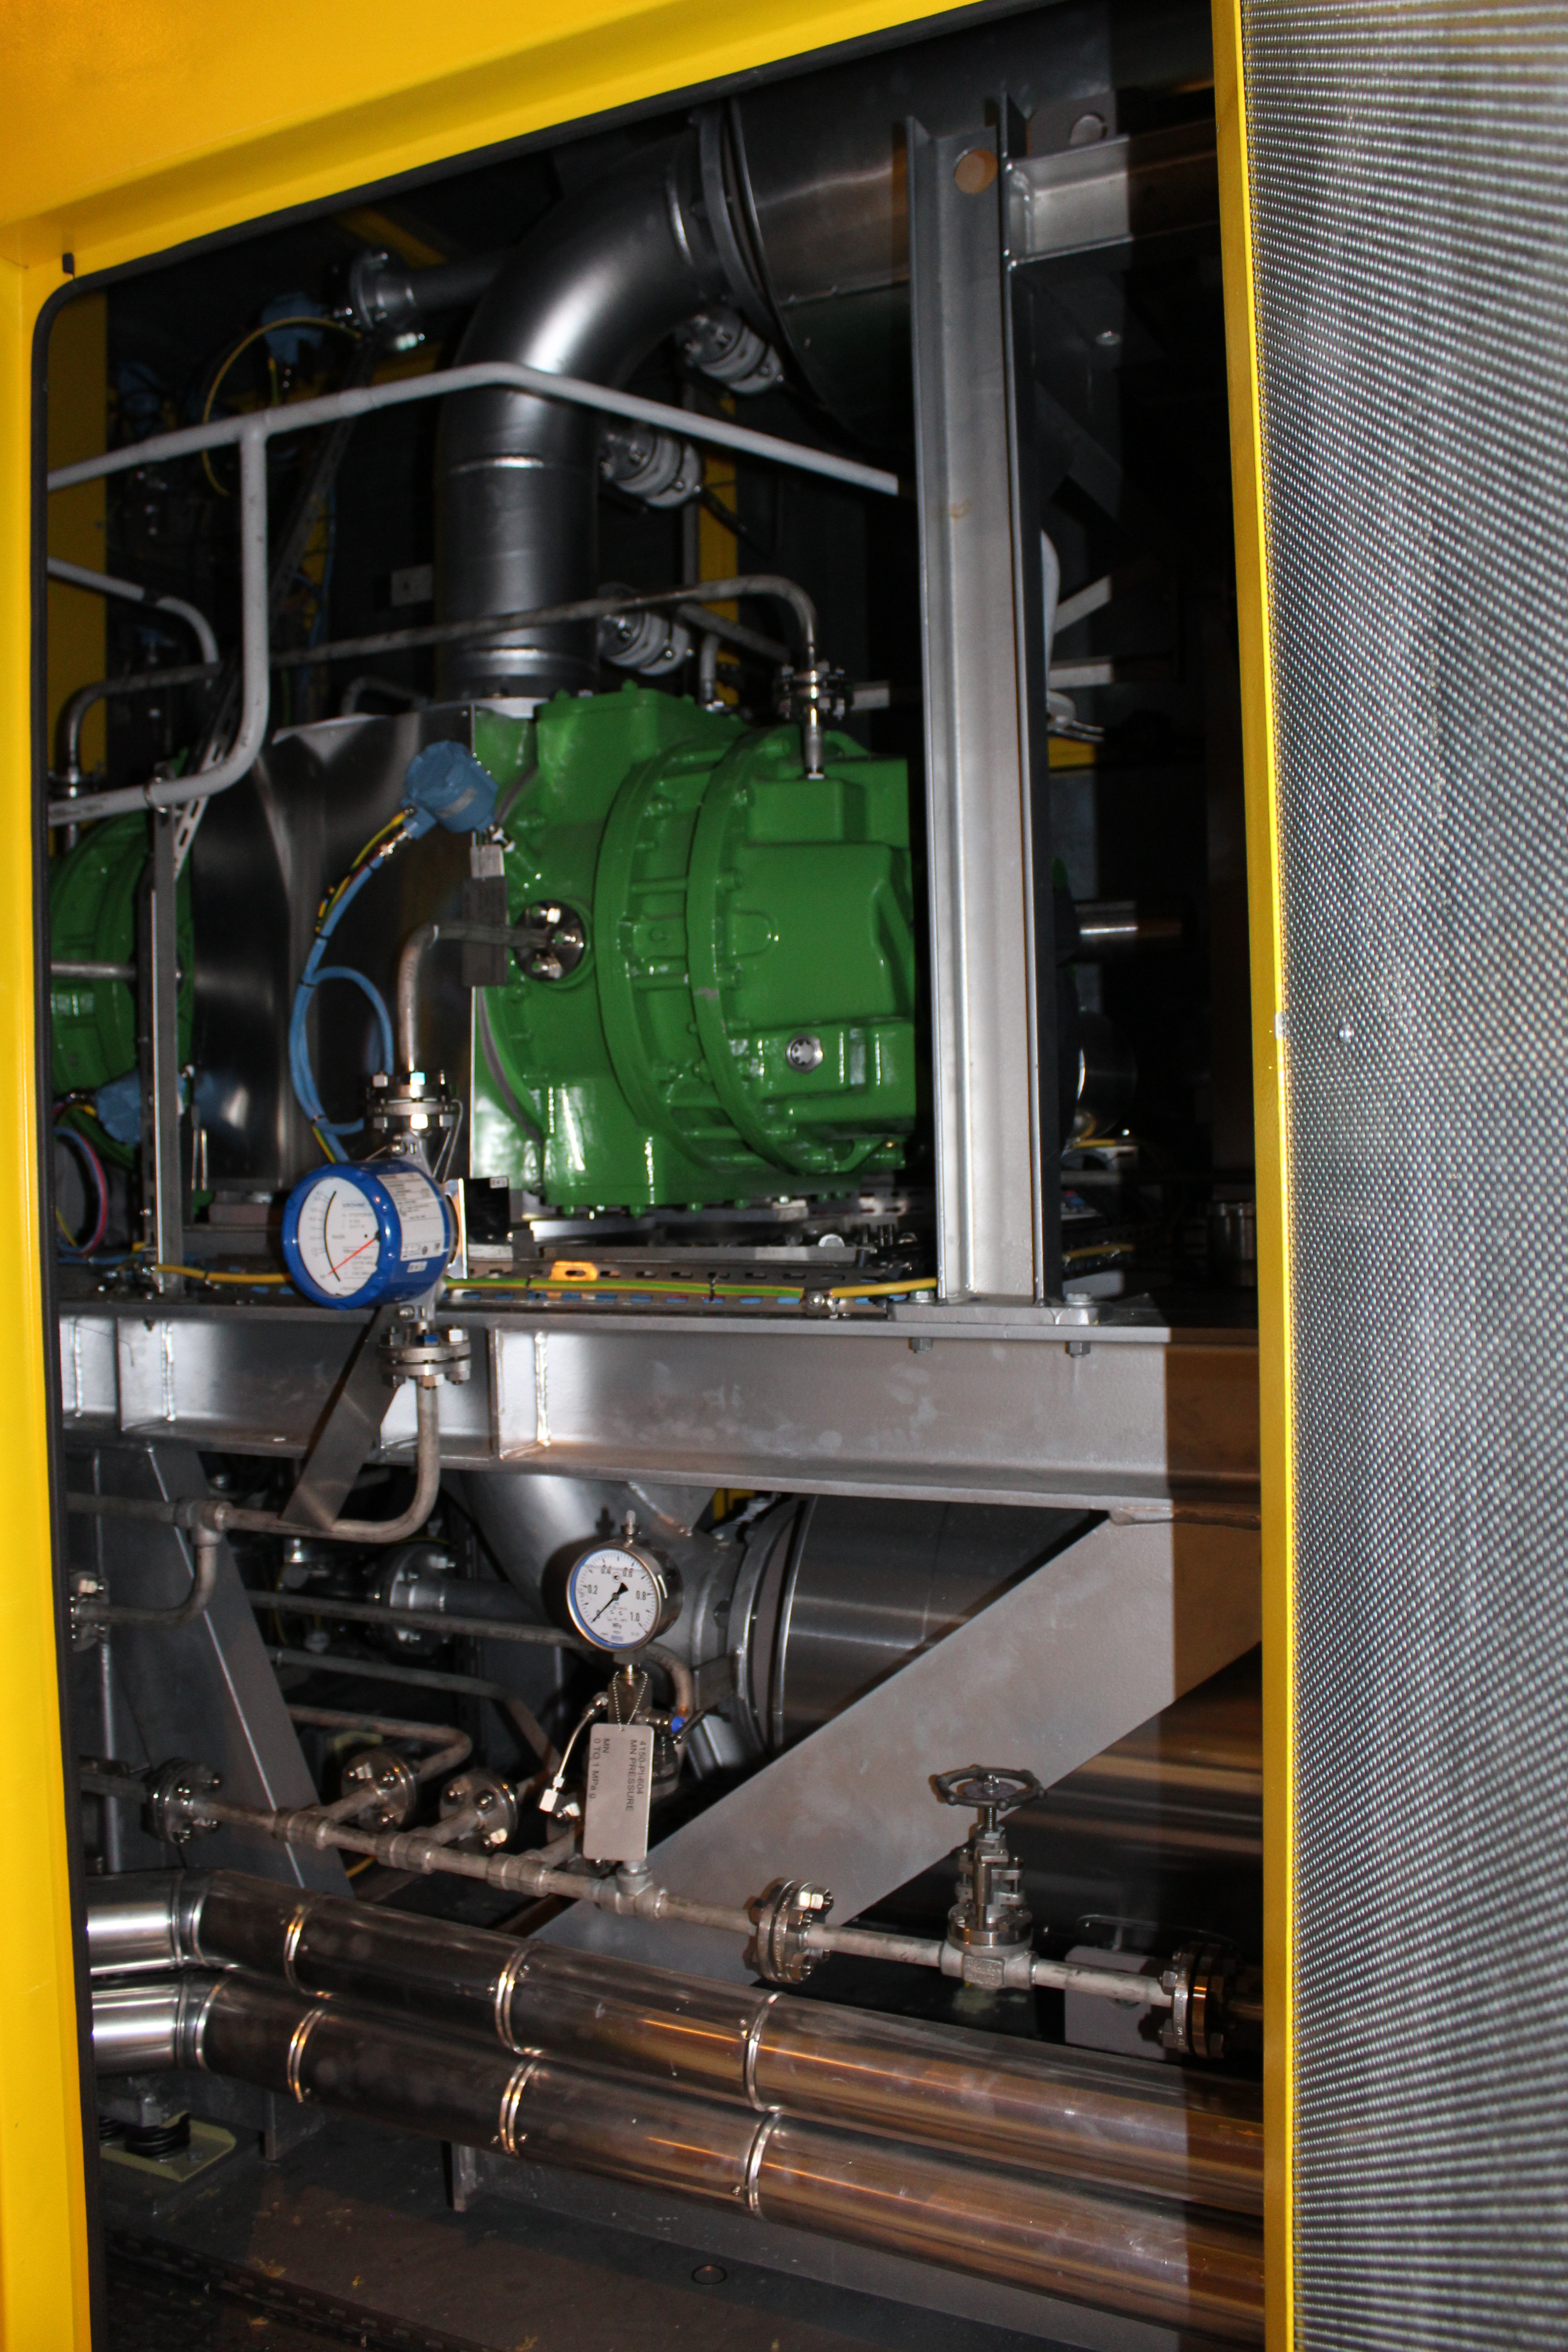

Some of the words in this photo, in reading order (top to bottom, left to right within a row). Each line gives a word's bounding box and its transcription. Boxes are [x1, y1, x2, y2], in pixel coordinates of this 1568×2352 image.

[601, 1565, 611, 1574] 0.4
[622, 1568, 633, 1578] 0.6
[588, 1584, 598, 1594] 0.2
[636, 1591, 647, 1600] 0.8
[630, 1612, 640, 1622] 1.0
[603, 1738, 610, 1754] MN
[629, 1740, 637, 1755] MN
[593, 1747, 601, 1759] TO
[626, 1758, 636, 1812] PRESSURE
